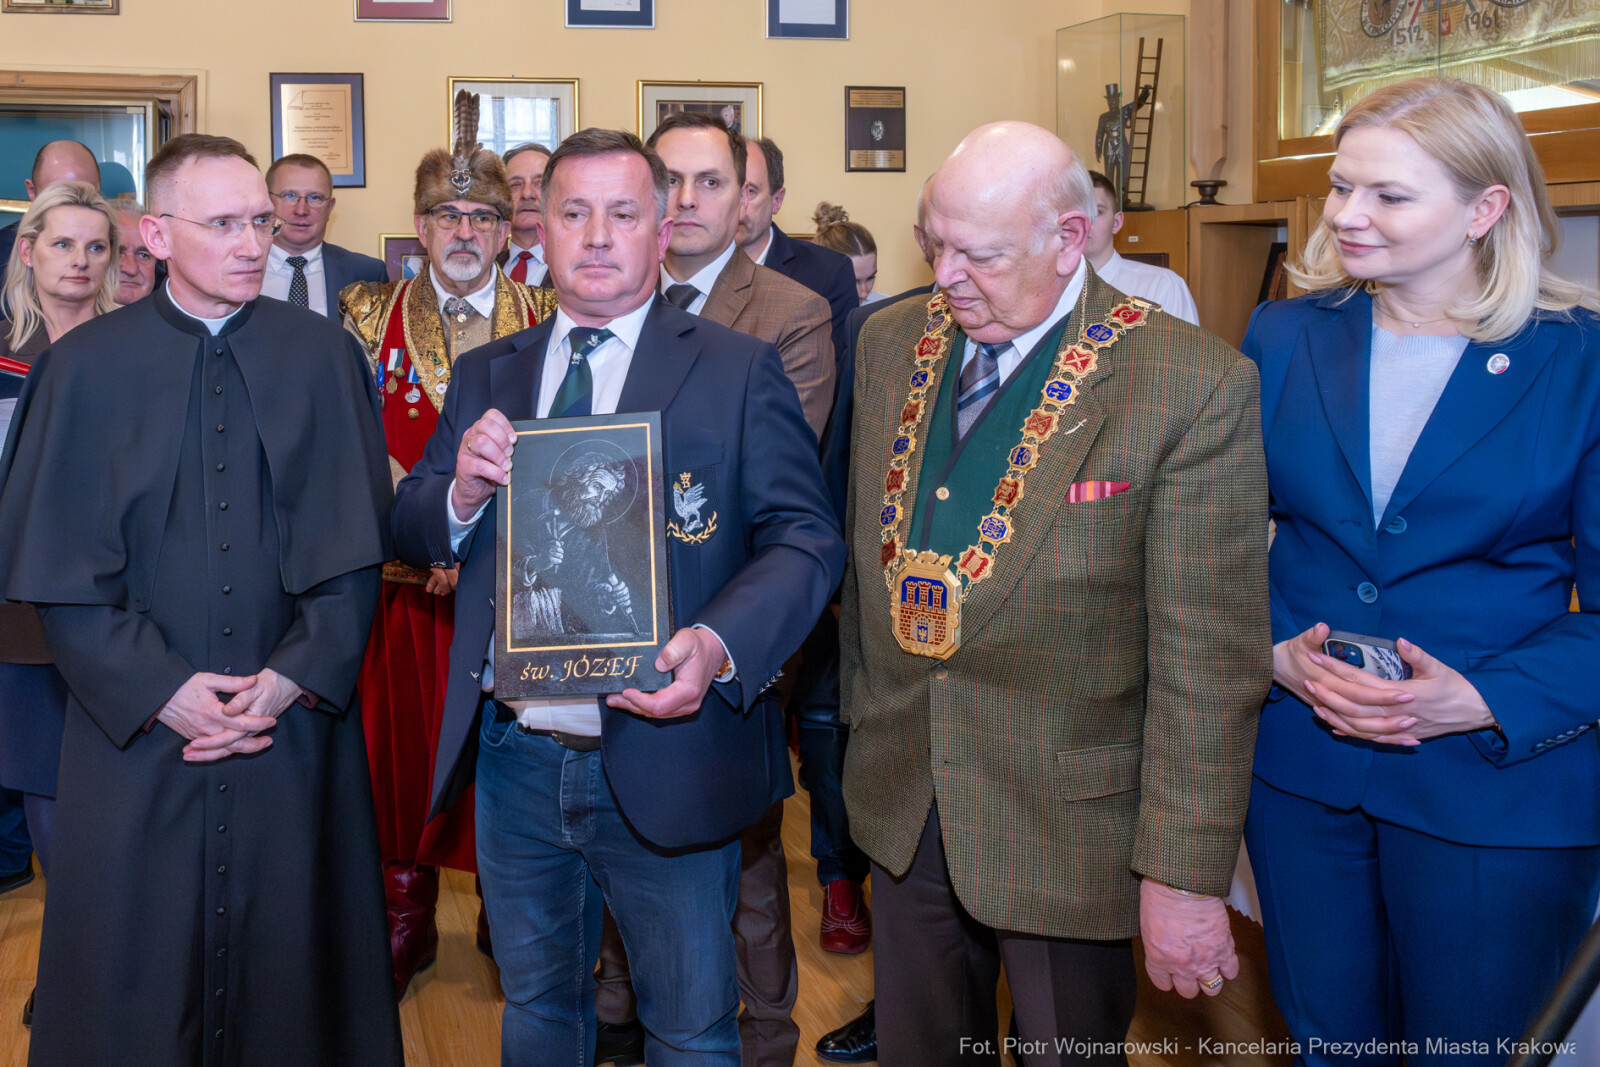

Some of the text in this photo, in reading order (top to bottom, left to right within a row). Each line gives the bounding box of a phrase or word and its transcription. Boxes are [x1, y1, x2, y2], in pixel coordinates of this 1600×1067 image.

[1464, 8, 1500, 32] 1961
[1390, 25, 1425, 46] 1512
[520, 654, 643, 682] św. JÓZEF
